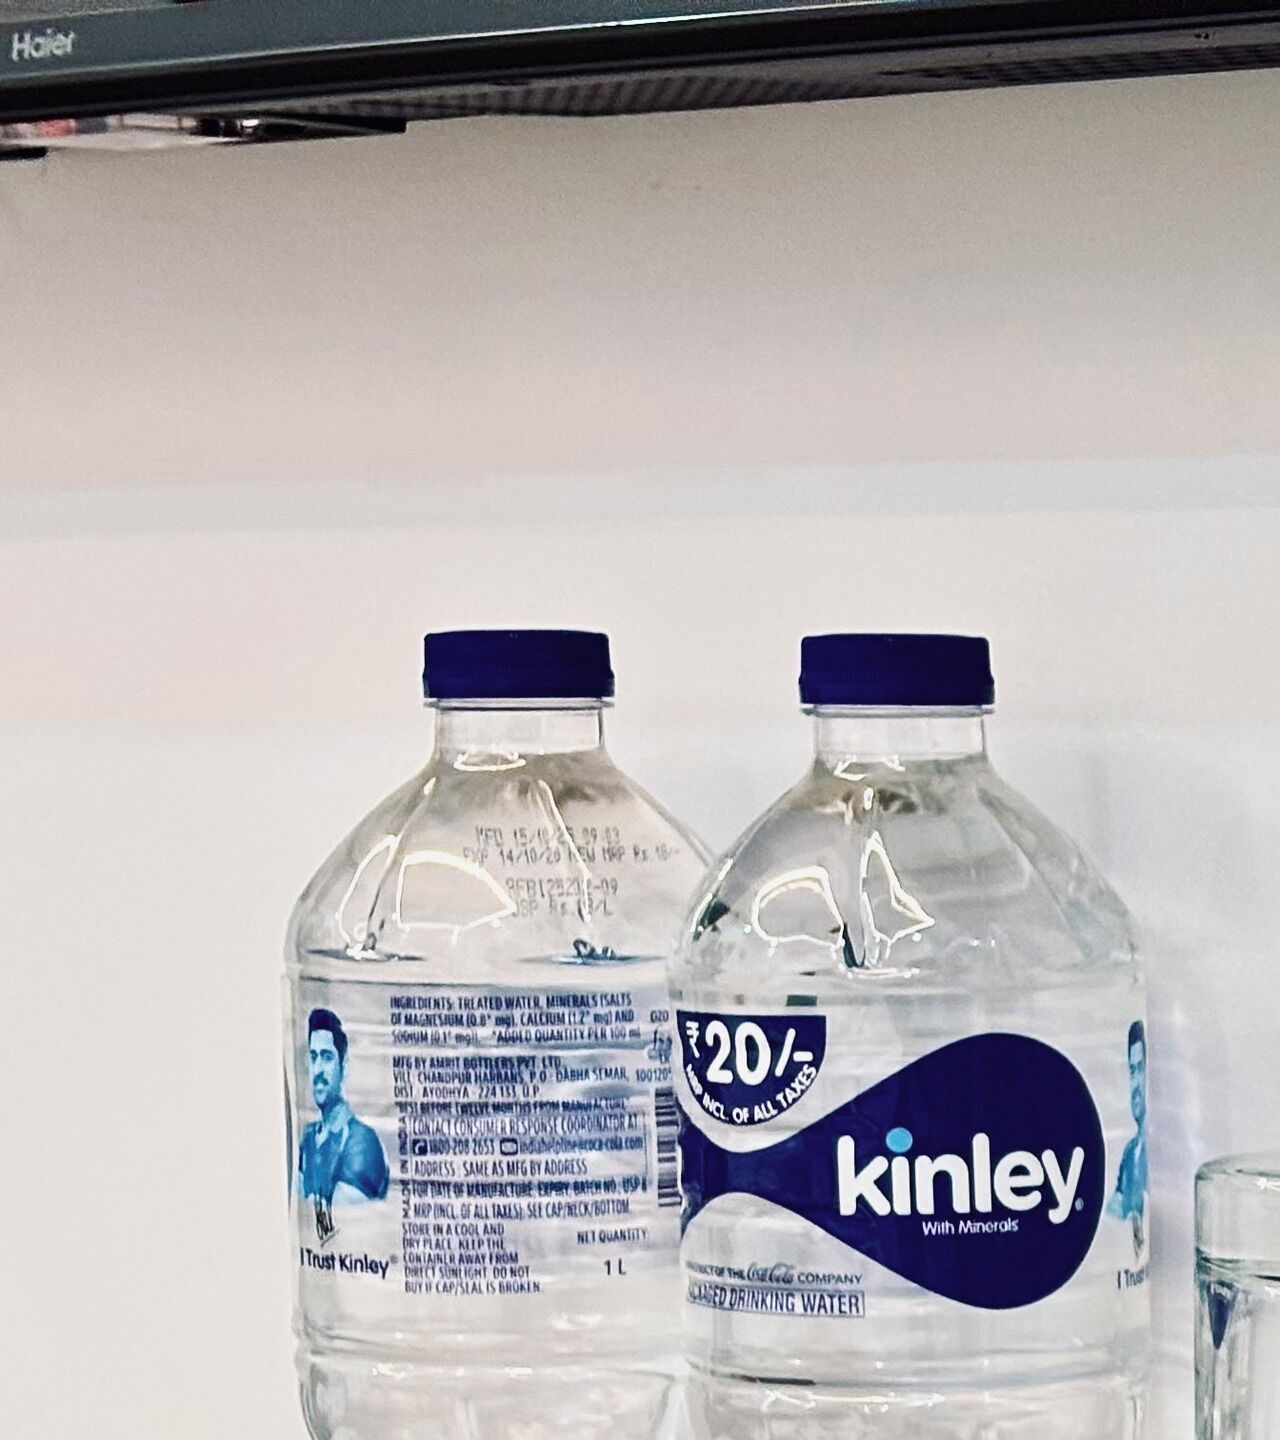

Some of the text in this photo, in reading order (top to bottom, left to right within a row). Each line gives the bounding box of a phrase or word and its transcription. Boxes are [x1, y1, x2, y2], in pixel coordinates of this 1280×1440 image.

[12, 28, 75, 62] Haier
[458, 996, 503, 1010] TREATED
[546, 994, 598, 1009] MINERALS
[391, 1013, 402, 1026] OF
[404, 1012, 465, 1027] MAGNESIUM
[520, 1010, 566, 1027] CALCIUM
[615, 1008, 635, 1023] AND
[535, 1027, 585, 1042] QUANTITY
[588, 1027, 607, 1041] PER
[610, 1028, 627, 1041] 100
[415, 1056, 427, 1069] BY
[429, 1056, 461, 1069] AMRIT
[463, 1055, 515, 1070] BOTTLERS
[418, 1070, 472, 1084] CHANDPUR
[422, 1085, 470, 1099] AYODHYA
[732, 1107, 750, 1124] OF
[753, 1099, 779, 1122] ALL
[775, 1063, 817, 1109] TAXES
[413, 1111, 638, 1136] CONTACT CONSUMER RESPONSE COORDINATOR AT
[463, 1159, 490, 1178] SAME
[491, 1159, 504, 1177] AS
[506, 1159, 528, 1177] MFG
[530, 1159, 543, 1177] BY
[544, 1157, 588, 1177] ADDRESS
[838, 1127, 1085, 1225] kinley
[414, 1202, 432, 1219] MRP
[460, 1202, 472, 1219] OF
[474, 1202, 490, 1219] ALL
[527, 1200, 543, 1219] SEE
[402, 1221, 505, 1236] STORE IN A COOL AND
[577, 1227, 648, 1244] NET QUANTITY
[922, 1217, 1019, 1236] With Minerals
[403, 1237, 421, 1251] DRY
[458, 1237, 485, 1251] KEEP
[487, 1237, 506, 1250] THE
[300, 1247, 389, 1280] I Trust Kinley
[403, 1251, 519, 1266] CONTAINER AWAY FROM
[604, 1258, 628, 1276] 1 L
[404, 1266, 437, 1280] DIRECT
[493, 1266, 509, 1278] DO
[510, 1265, 531, 1278] NOT
[727, 1266, 746, 1281] THE
[797, 1272, 863, 1285] COMPANY
[405, 1280, 424, 1294] BUY
[487, 1280, 497, 1293] IS
[730, 1286, 796, 1313] DRINKING
[801, 1292, 861, 1315] WATER
